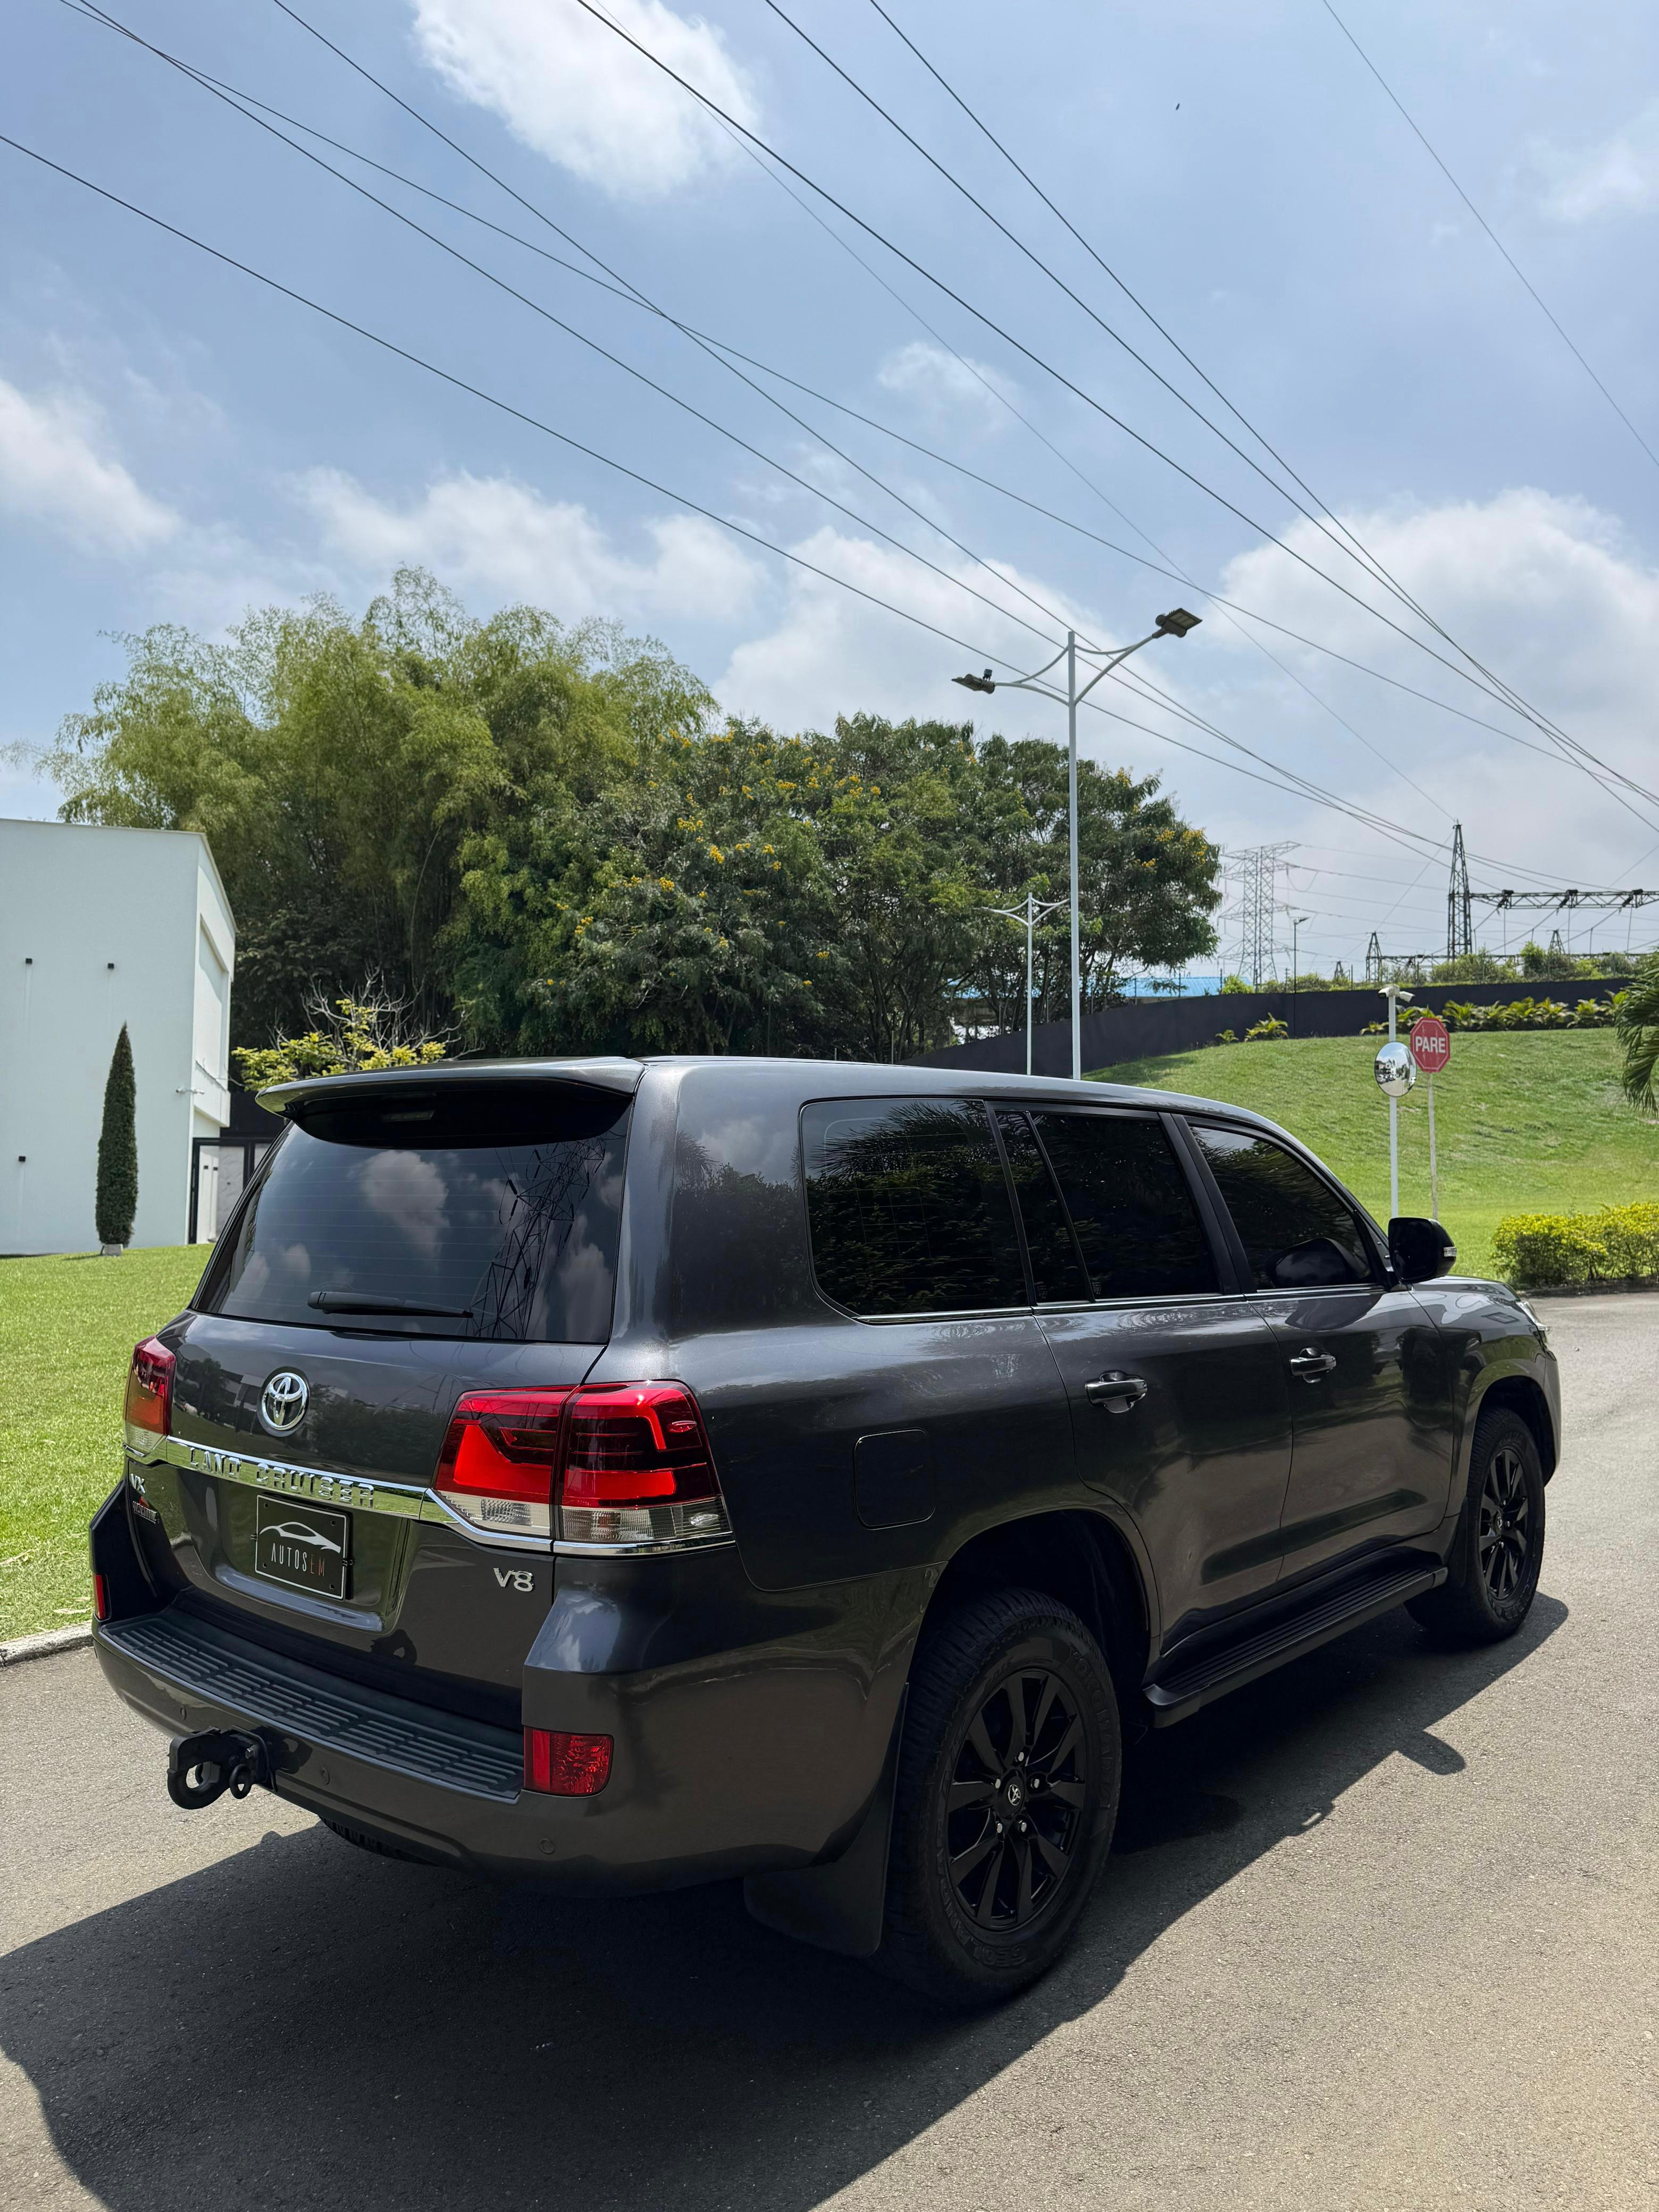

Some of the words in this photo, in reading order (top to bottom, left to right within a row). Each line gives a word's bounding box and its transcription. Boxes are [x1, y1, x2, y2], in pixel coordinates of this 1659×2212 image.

[1415, 1036, 1446, 1053] PARE
[190, 1447, 242, 1478] LAND
[256, 1462, 374, 1508] CRUISER
[493, 1568, 534, 1591] V8
[1066, 1643, 1114, 1808] YOKOHAMA
